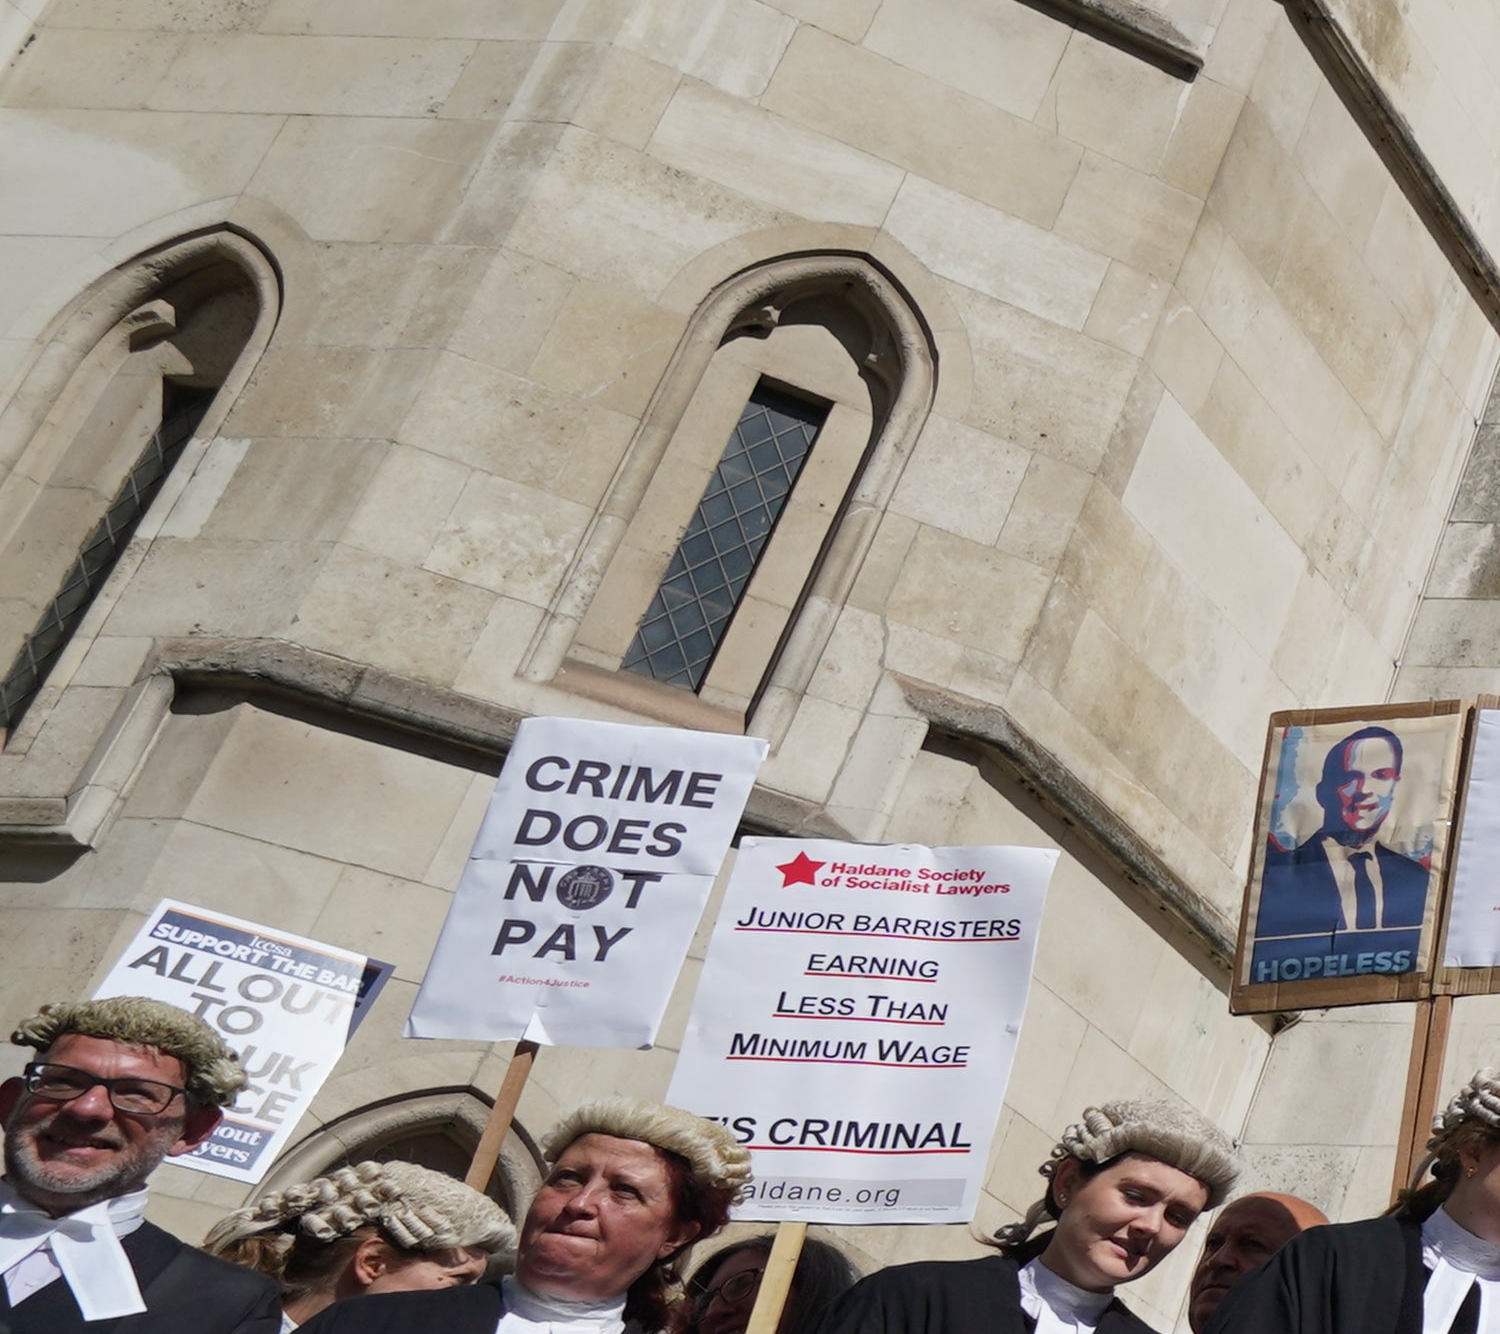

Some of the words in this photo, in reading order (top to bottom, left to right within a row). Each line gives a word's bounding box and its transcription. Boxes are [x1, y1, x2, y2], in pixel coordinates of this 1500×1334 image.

[524, 755, 723, 809] CRIME
[513, 808, 688, 858] DOES
[820, 876, 841, 887] of
[845, 877, 929, 894] Socialist
[935, 883, 1011, 897] Lawyers
[830, 862, 910, 878] Haldane
[917, 867, 986, 883] Society
[737, 907, 845, 931] JUNIOR
[852, 916, 1022, 938] BARRISTERS
[490, 918, 635, 963] PAY
[152, 922, 270, 965] SUPPORT
[272, 954, 314, 980] THE
[317, 967, 363, 994] BAR
[806, 954, 940, 978] EARNING
[1257, 950, 1412, 983] HOPELESS
[128, 945, 227, 993] ALL
[238, 974, 357, 1025] OUT
[498, 975, 590, 988] #Action4Justice
[191, 992, 264, 1035] TO
[776, 992, 855, 1016] LESS
[866, 995, 949, 1022] THAN
[729, 1033, 867, 1060] MINIMUM
[877, 1039, 971, 1064] WAGE
[768, 1118, 973, 1148] CRIMINAL
[742, 1181, 901, 1207] aldane.org
